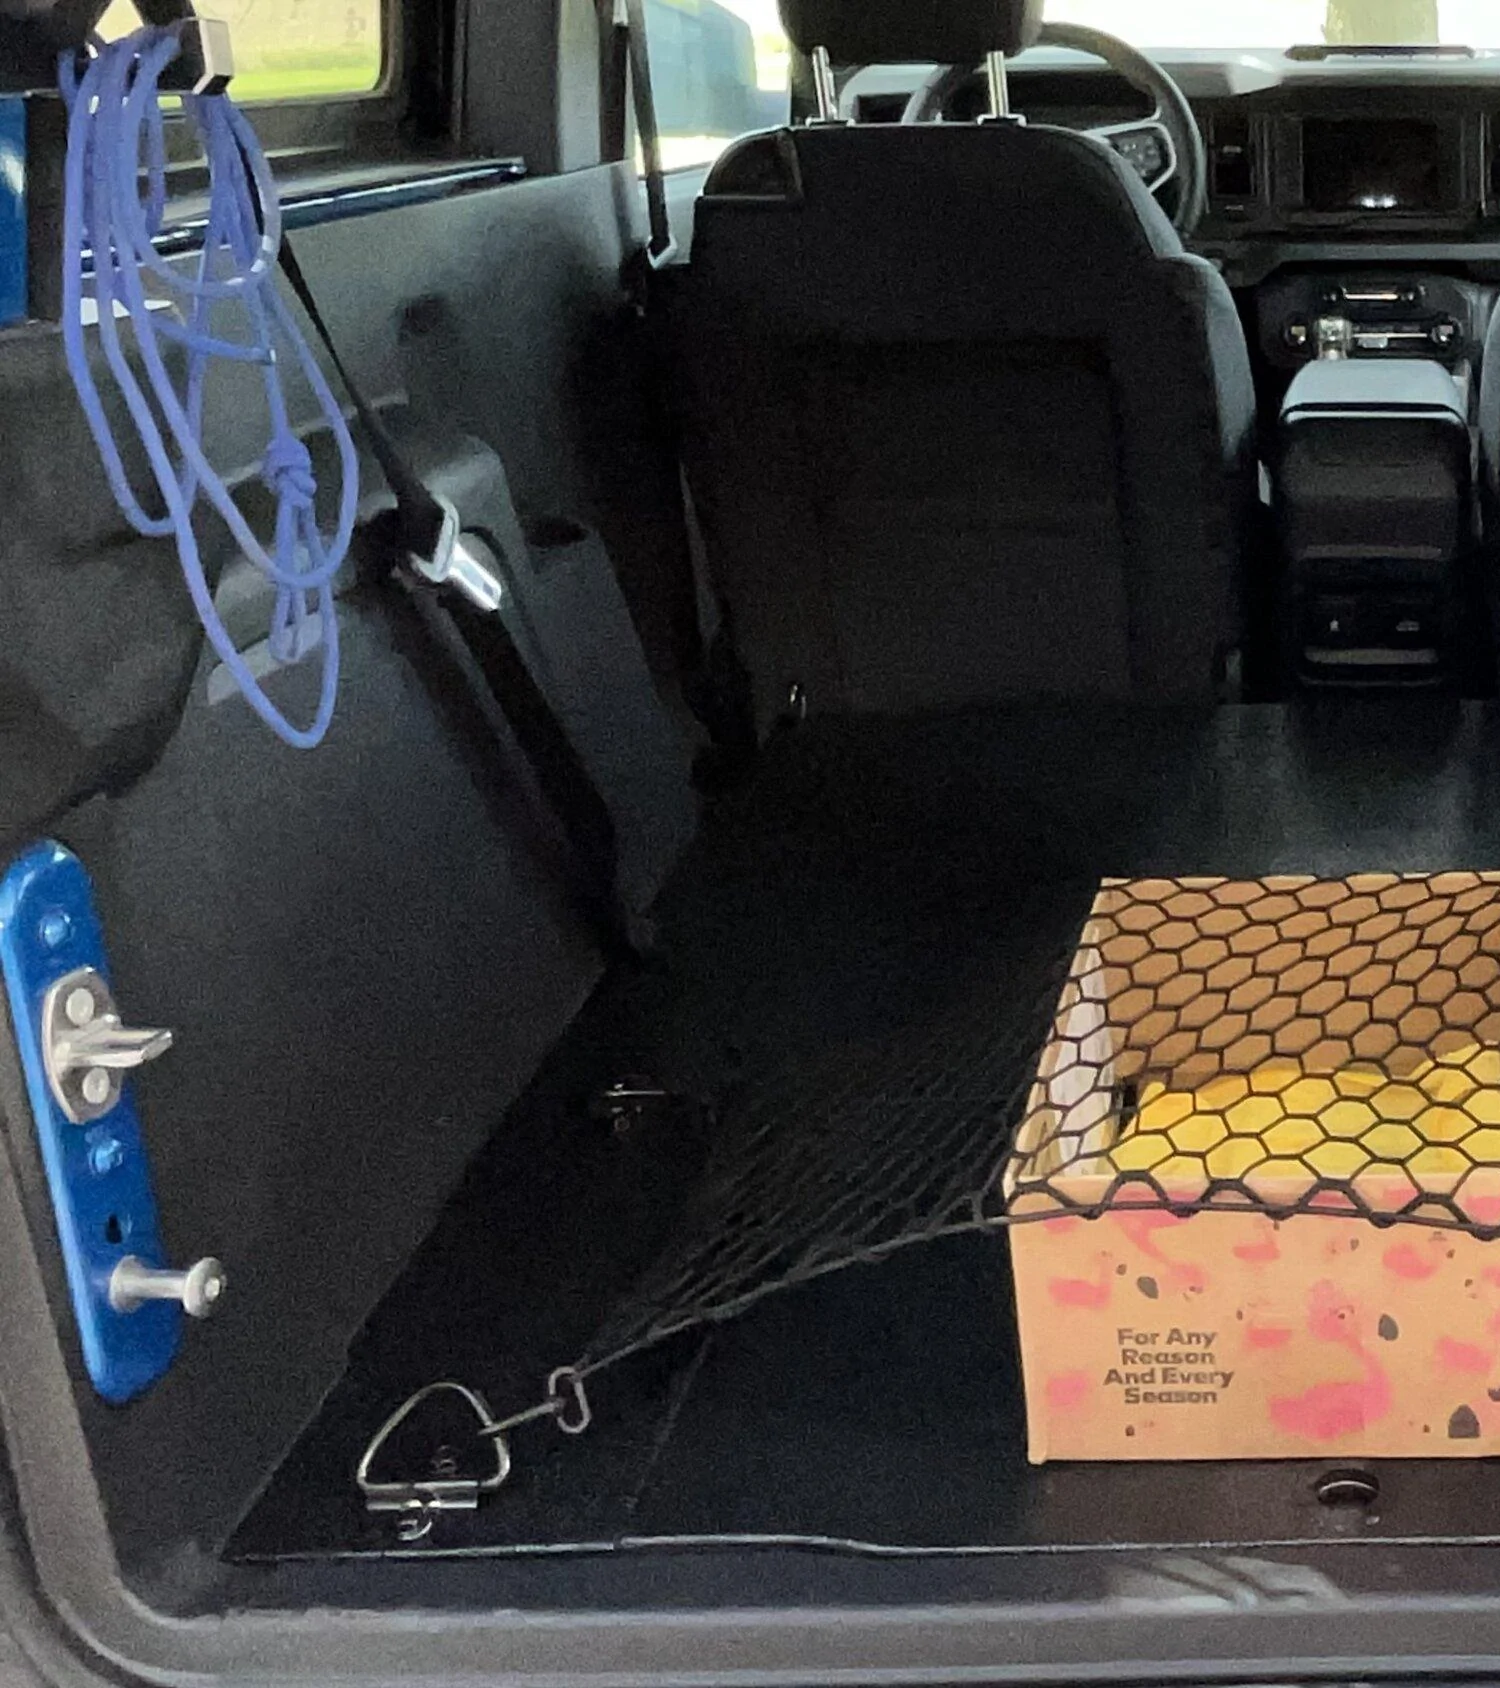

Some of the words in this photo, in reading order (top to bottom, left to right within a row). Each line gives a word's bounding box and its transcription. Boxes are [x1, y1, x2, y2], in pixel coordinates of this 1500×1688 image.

[1117, 1328, 1160, 1345] For
[1166, 1328, 1218, 1348] Any
[1122, 1348, 1215, 1365] Reason
[1103, 1367, 1156, 1385] And
[1162, 1367, 1235, 1388] Every
[1124, 1387, 1218, 1404] Season
